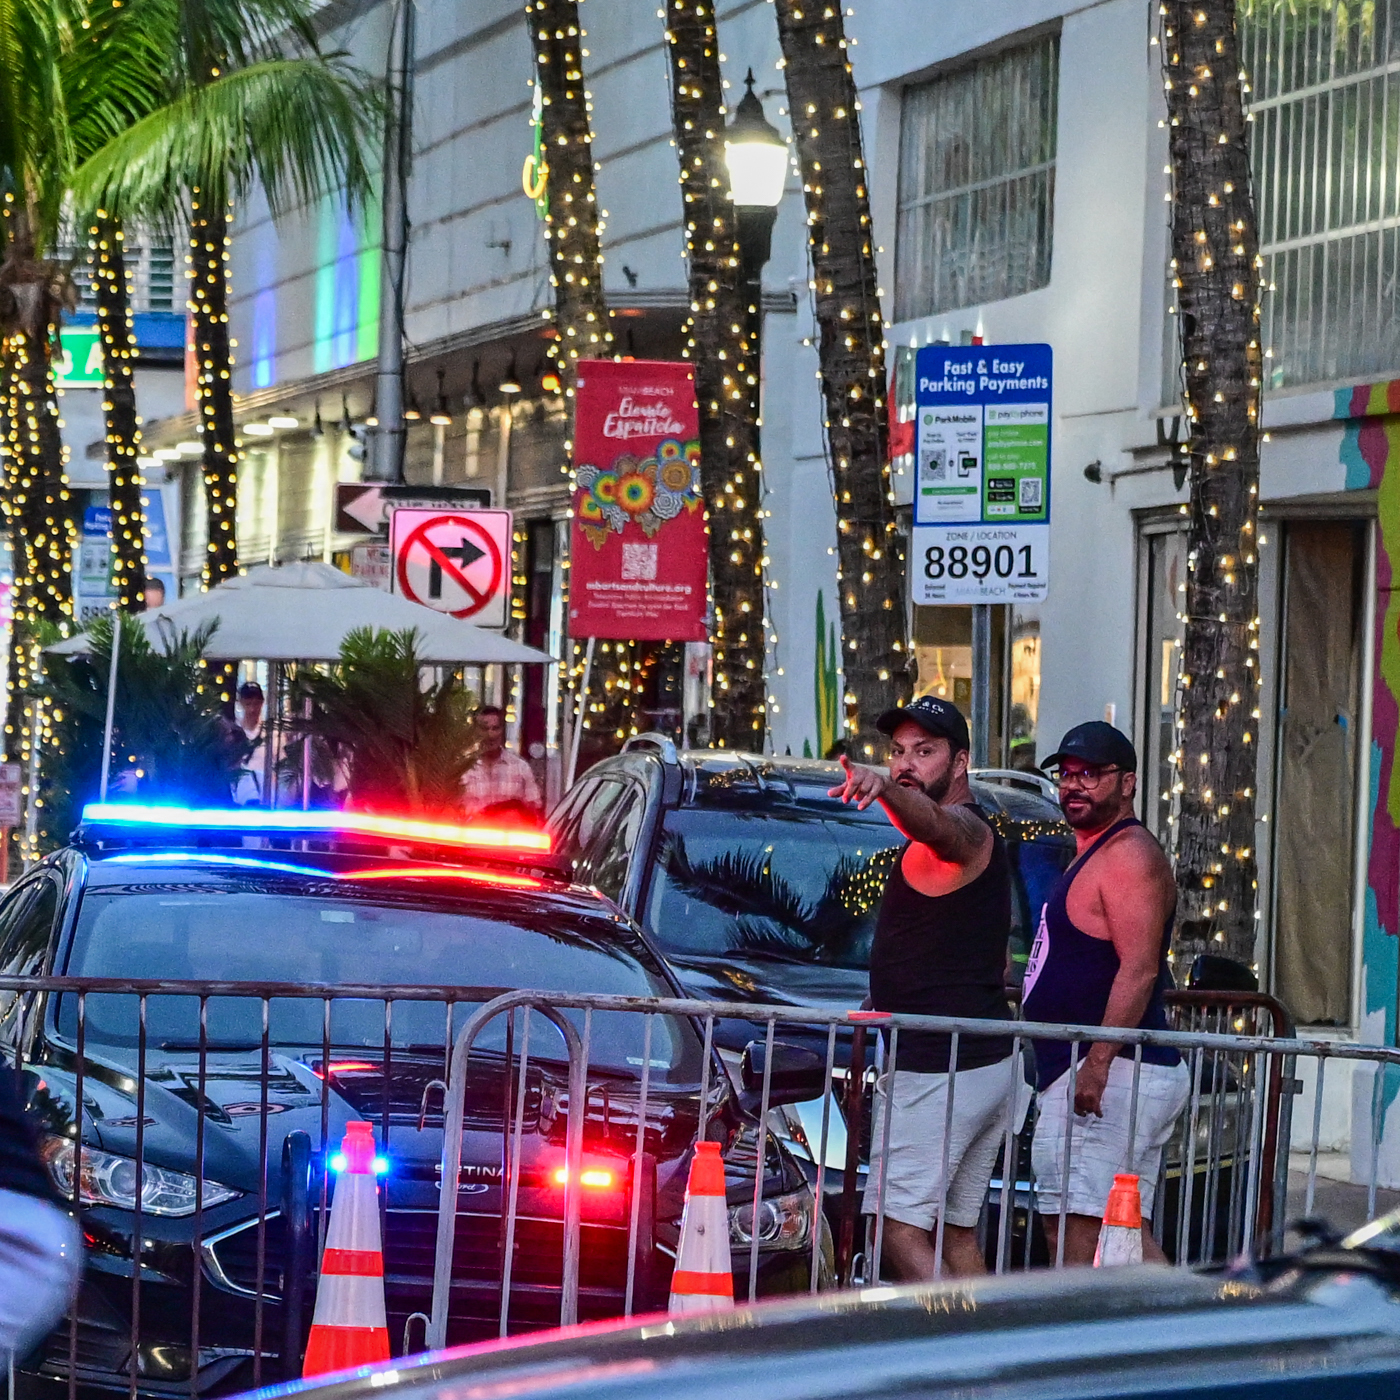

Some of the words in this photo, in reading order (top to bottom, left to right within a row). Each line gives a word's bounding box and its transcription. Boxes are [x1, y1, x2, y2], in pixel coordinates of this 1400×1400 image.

[944, 360, 973, 375] Fast
[977, 359, 988, 375] &
[993, 359, 1025, 377] Easy
[920, 376, 975, 395] Parking
[980, 375, 1048, 394] Payments
[935, 415, 977, 424] ParkMobile
[946, 532, 969, 541] ZONE
[976, 531, 1017, 540] LOCATION
[924, 545, 1037, 579] 88901
